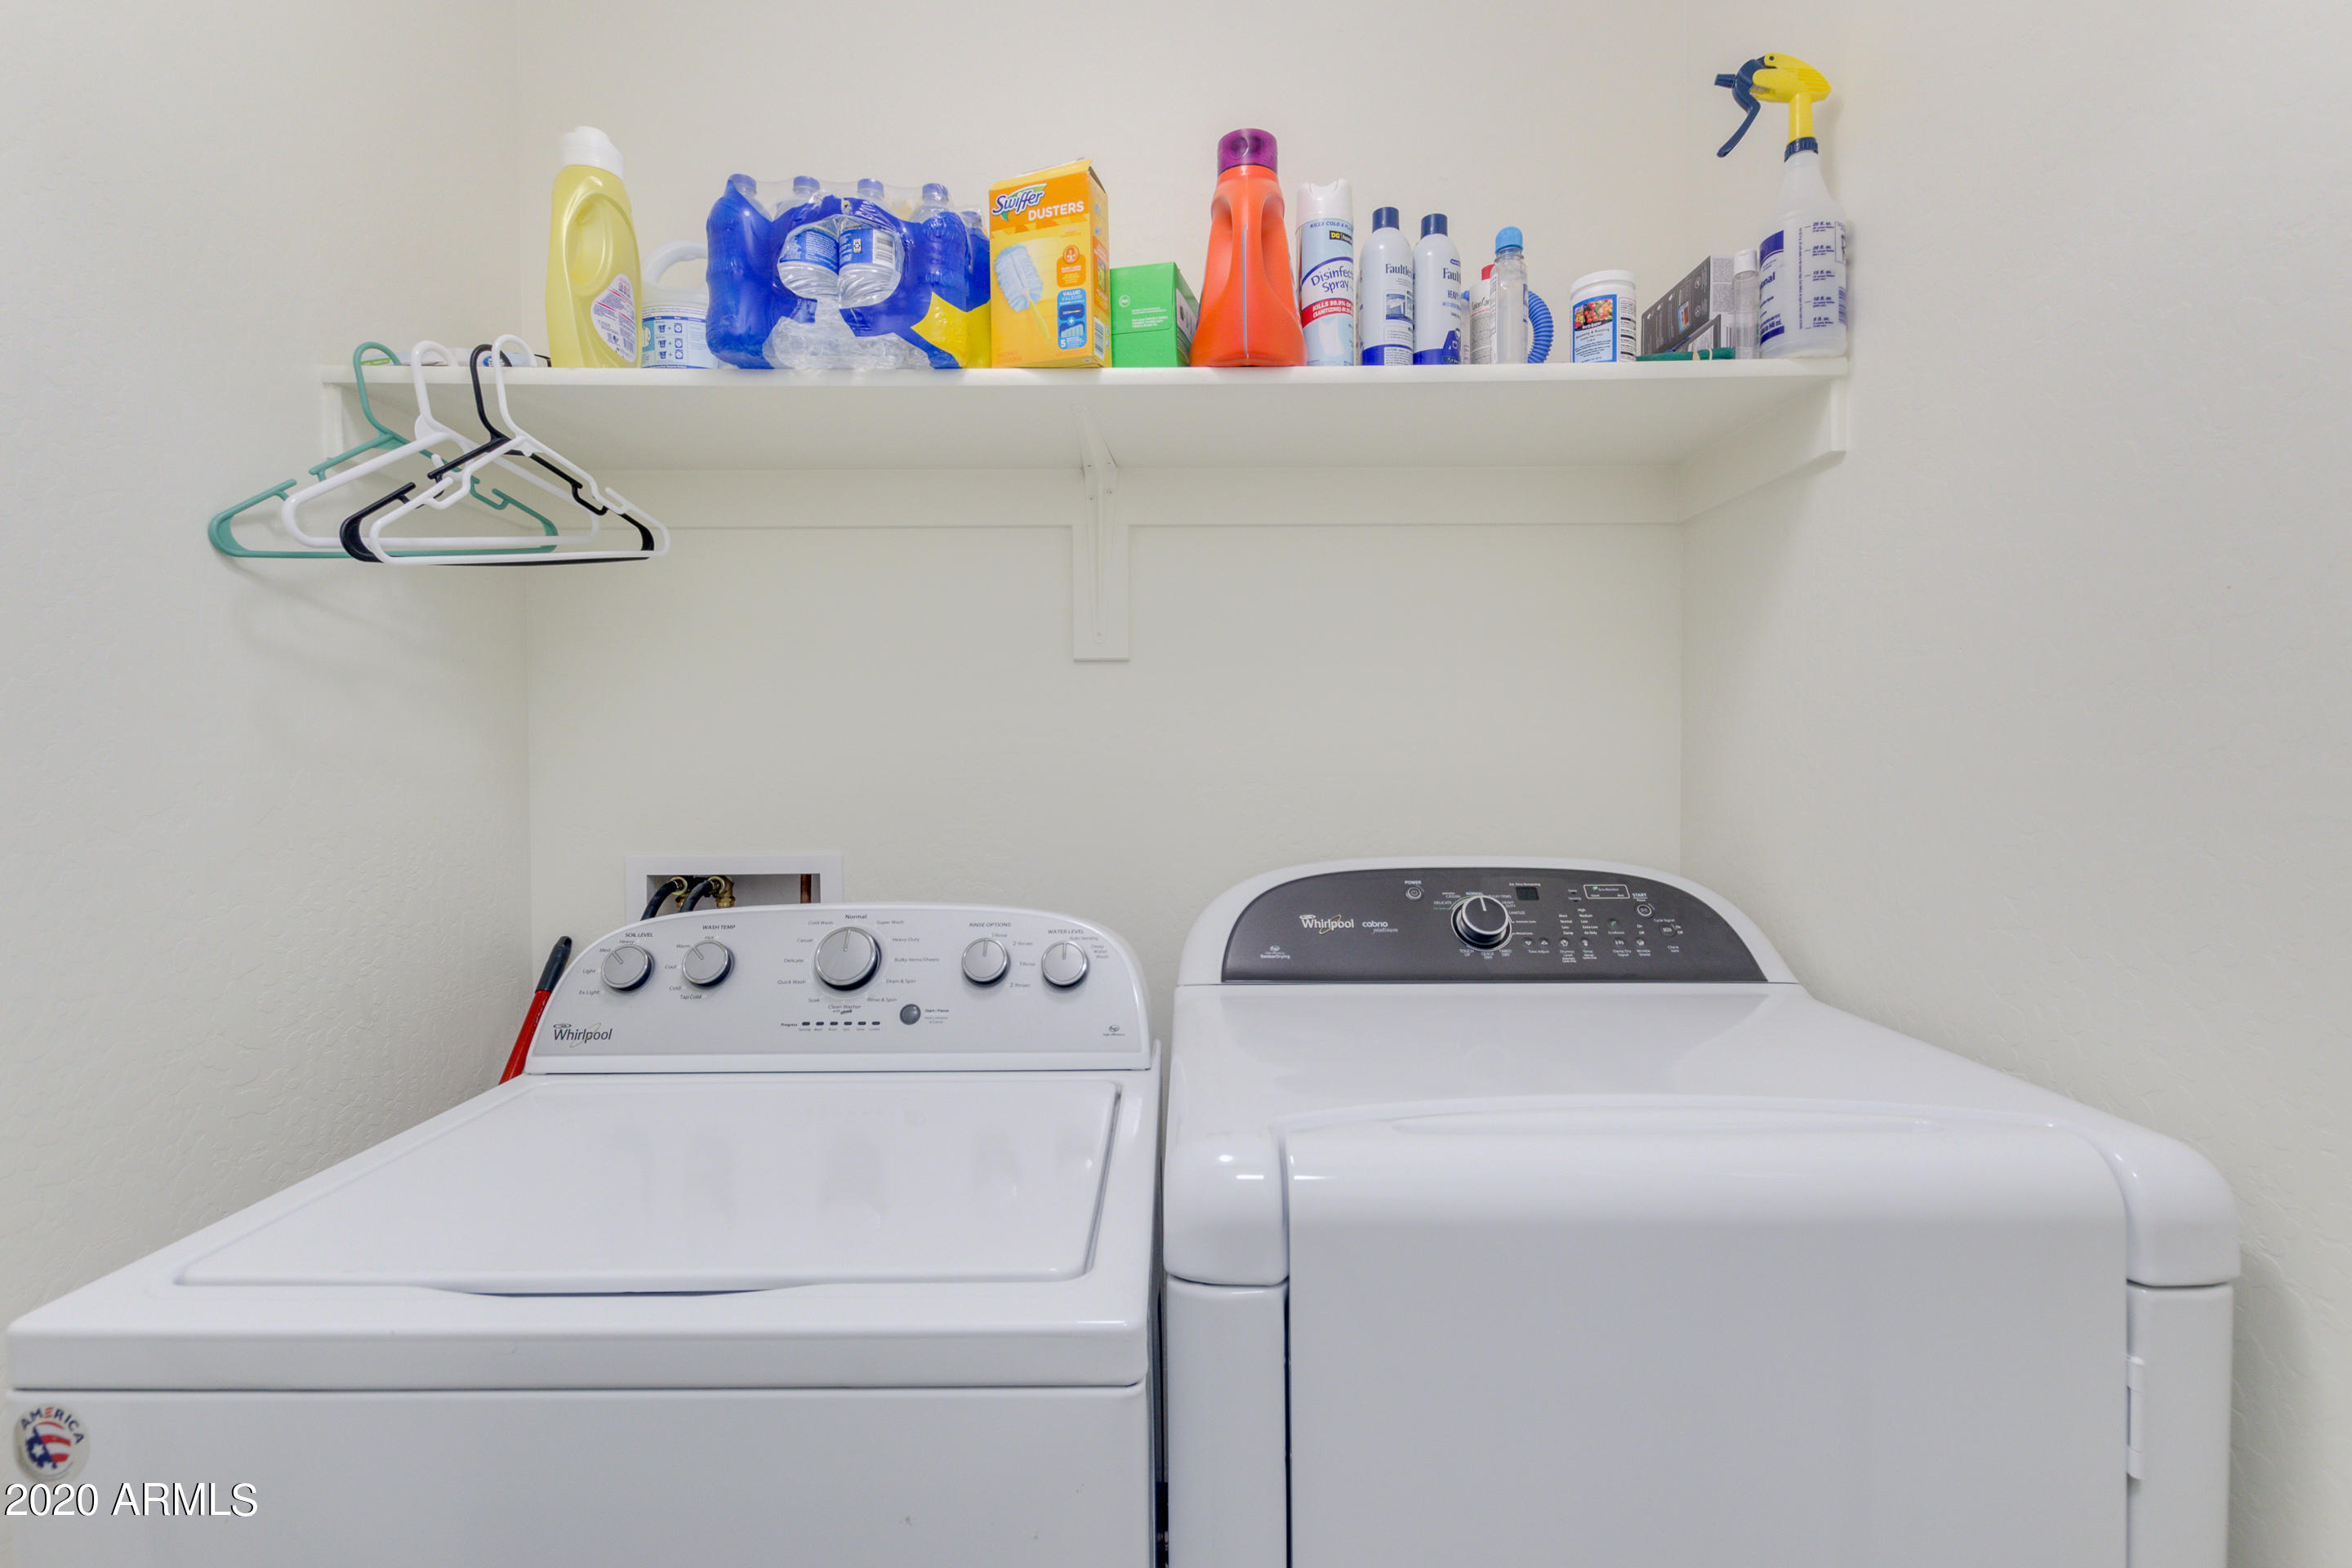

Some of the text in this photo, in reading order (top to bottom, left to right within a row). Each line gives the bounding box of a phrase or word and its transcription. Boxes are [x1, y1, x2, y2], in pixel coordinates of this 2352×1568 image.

[991, 190, 1045, 215] Swiffer
[1028, 201, 1085, 221] DUSTERS
[1322, 280, 1349, 293] Spray
[1302, 919, 1354, 931] Whirlpool
[553, 1028, 612, 1043] Whirlpool
[20, 1407, 85, 1445] AMERICA
